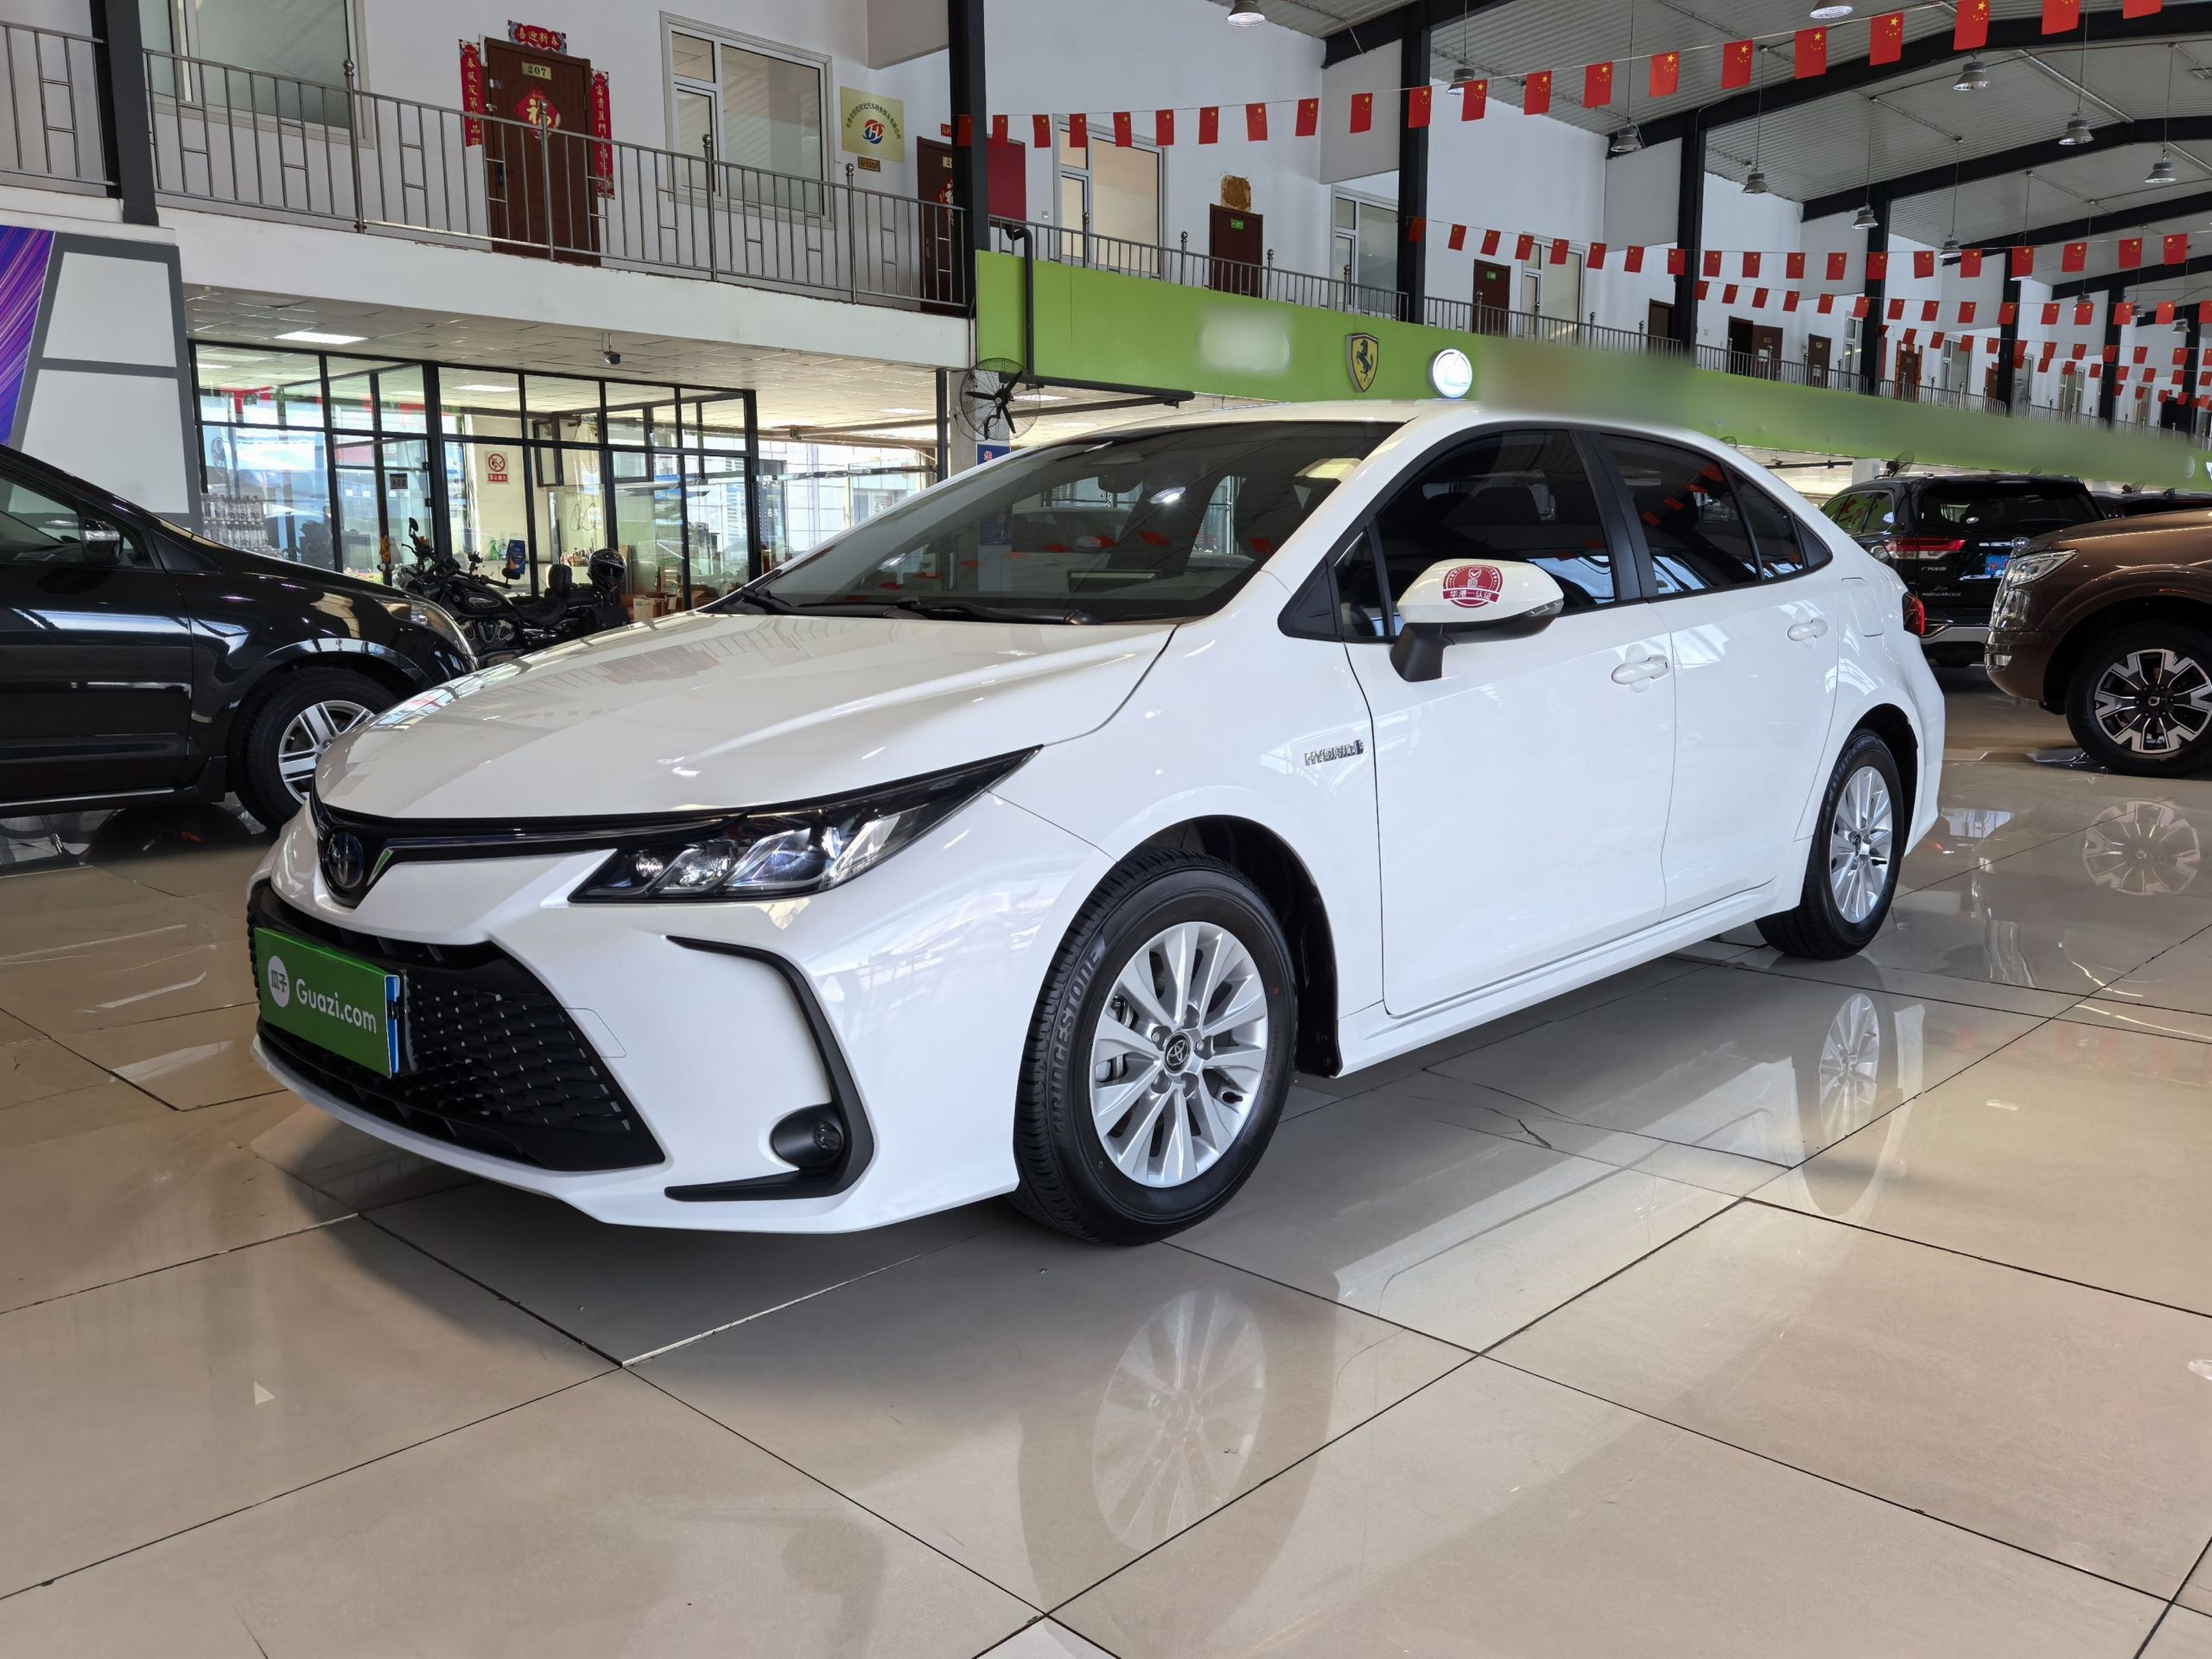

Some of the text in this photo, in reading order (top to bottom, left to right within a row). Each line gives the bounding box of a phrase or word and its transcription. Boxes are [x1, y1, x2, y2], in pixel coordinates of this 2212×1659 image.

[517, 27, 559, 47] 喜迎新春
[527, 66, 546, 77] 207
[1449, 589, 1493, 600] 华港一认证
[1304, 744, 1357, 766] HYBRID
[270, 969, 287, 994] 瓜子
[296, 978, 377, 1034] Guazi.com
[1048, 949, 1101, 1135] BRIDGESTONE
